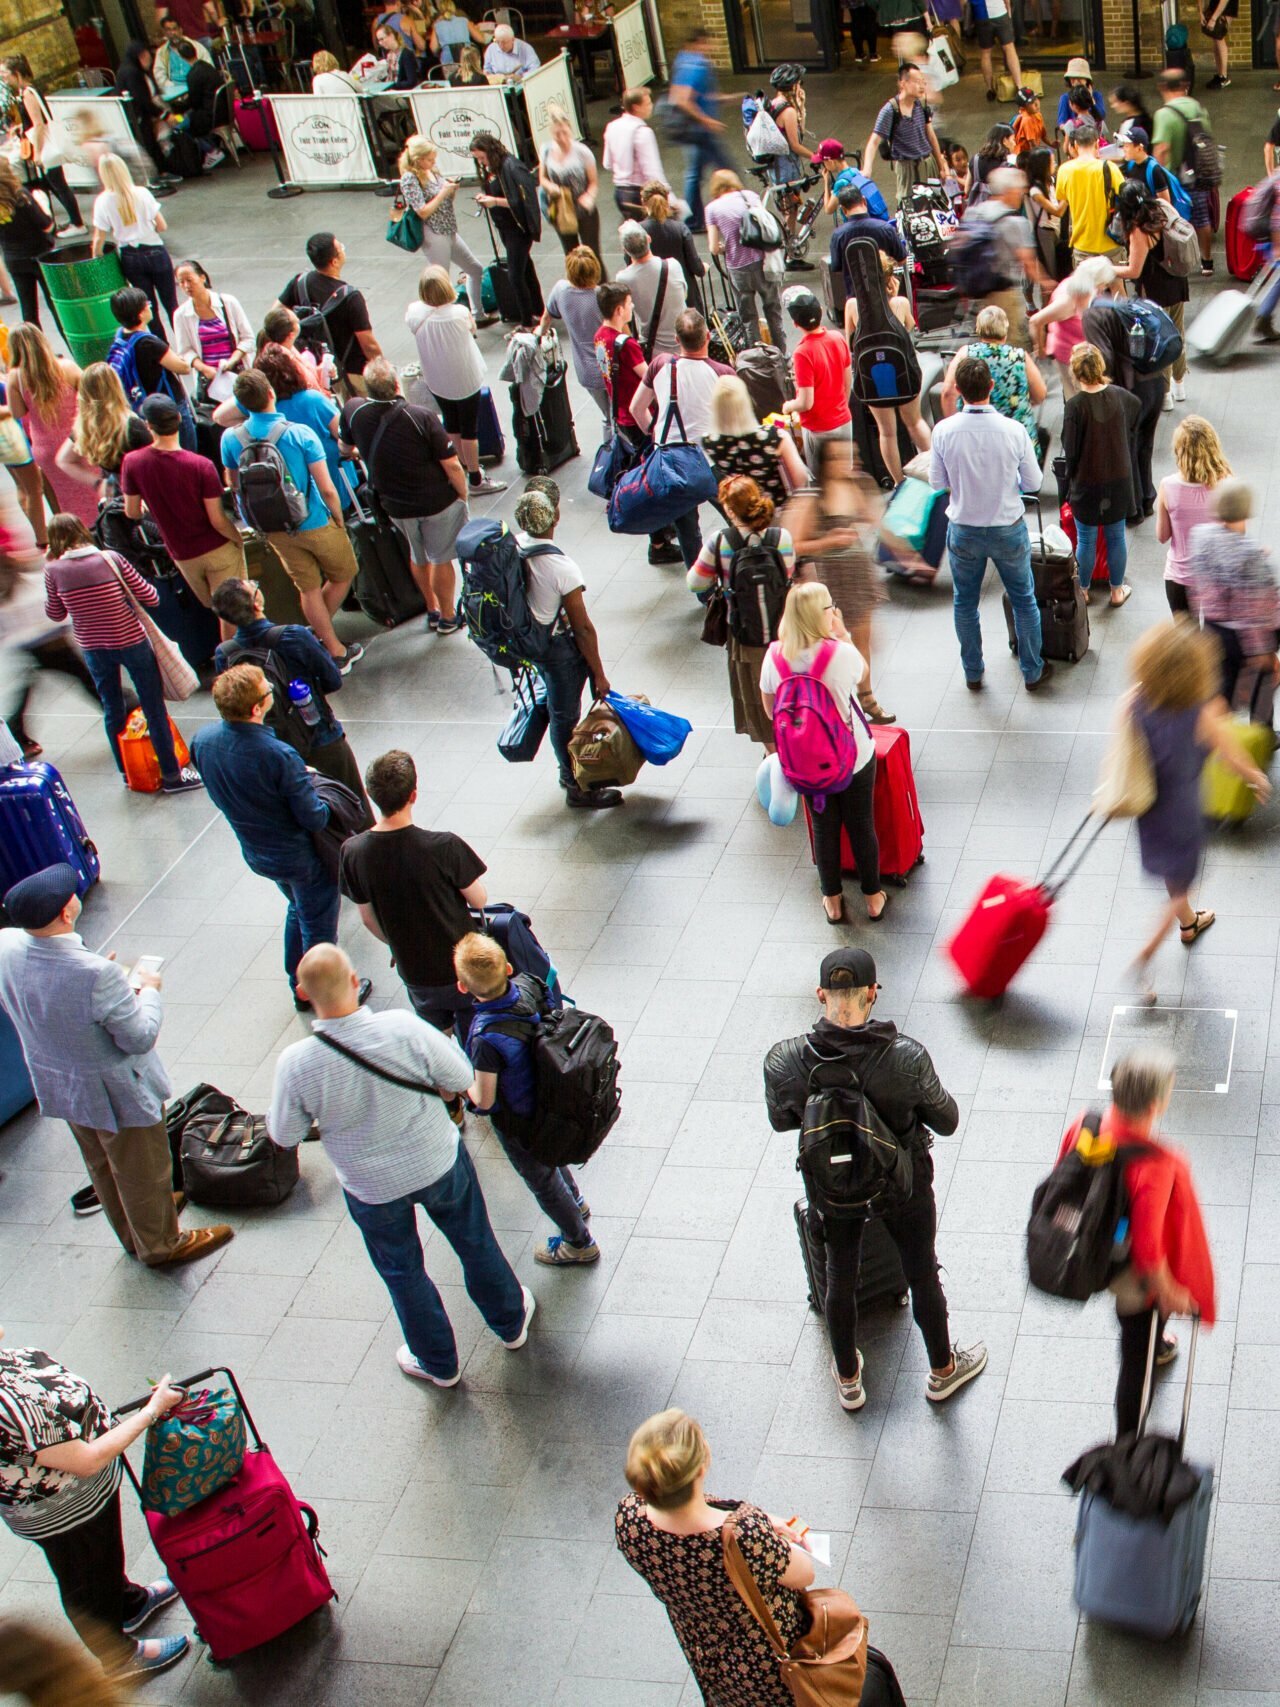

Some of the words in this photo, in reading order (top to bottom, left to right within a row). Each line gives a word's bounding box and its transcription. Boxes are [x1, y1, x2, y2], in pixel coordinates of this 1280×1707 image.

[452, 114, 472, 123] LEON
[312, 120, 330, 129] LEON
[438, 130, 452, 139] Fair
[453, 130, 471, 138] Trade
[312, 136, 329, 144] Trade
